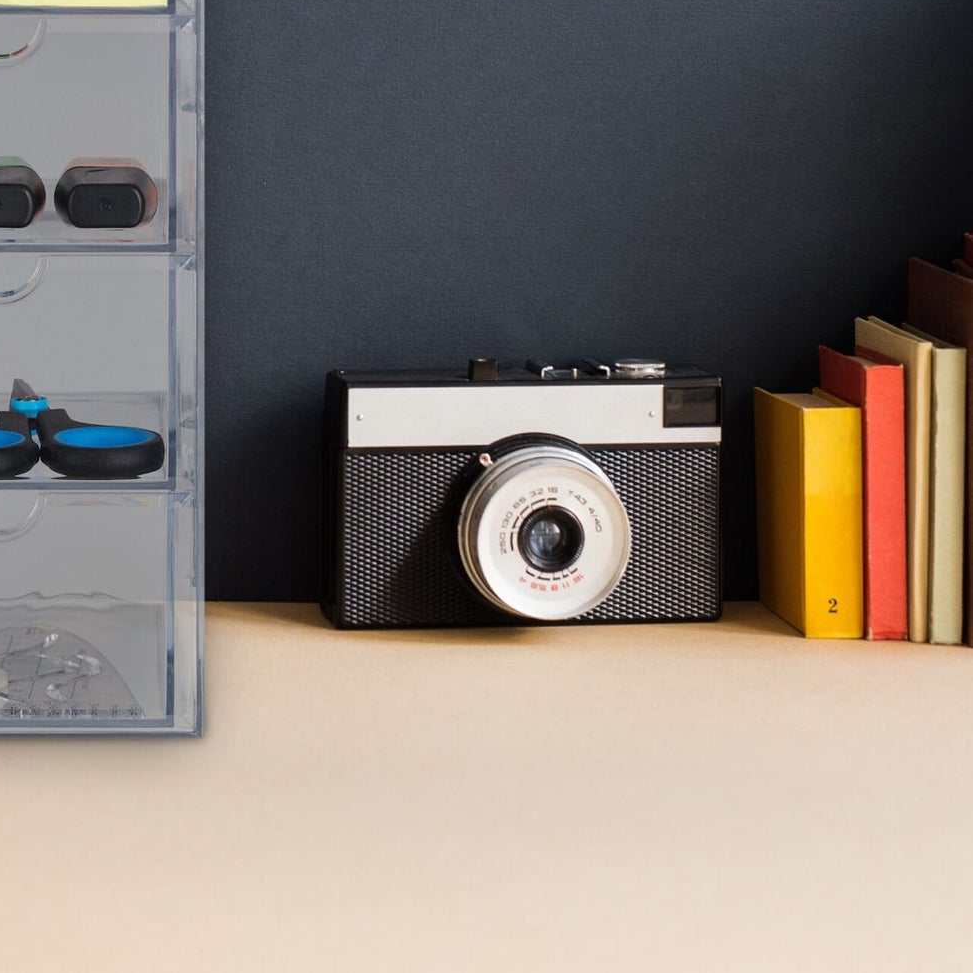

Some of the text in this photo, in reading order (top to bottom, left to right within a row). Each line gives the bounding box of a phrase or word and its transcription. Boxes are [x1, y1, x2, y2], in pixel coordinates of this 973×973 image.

[499, 532, 507, 554] 250
[528, 488, 544, 497] 32
[828, 598, 838, 613] 2
